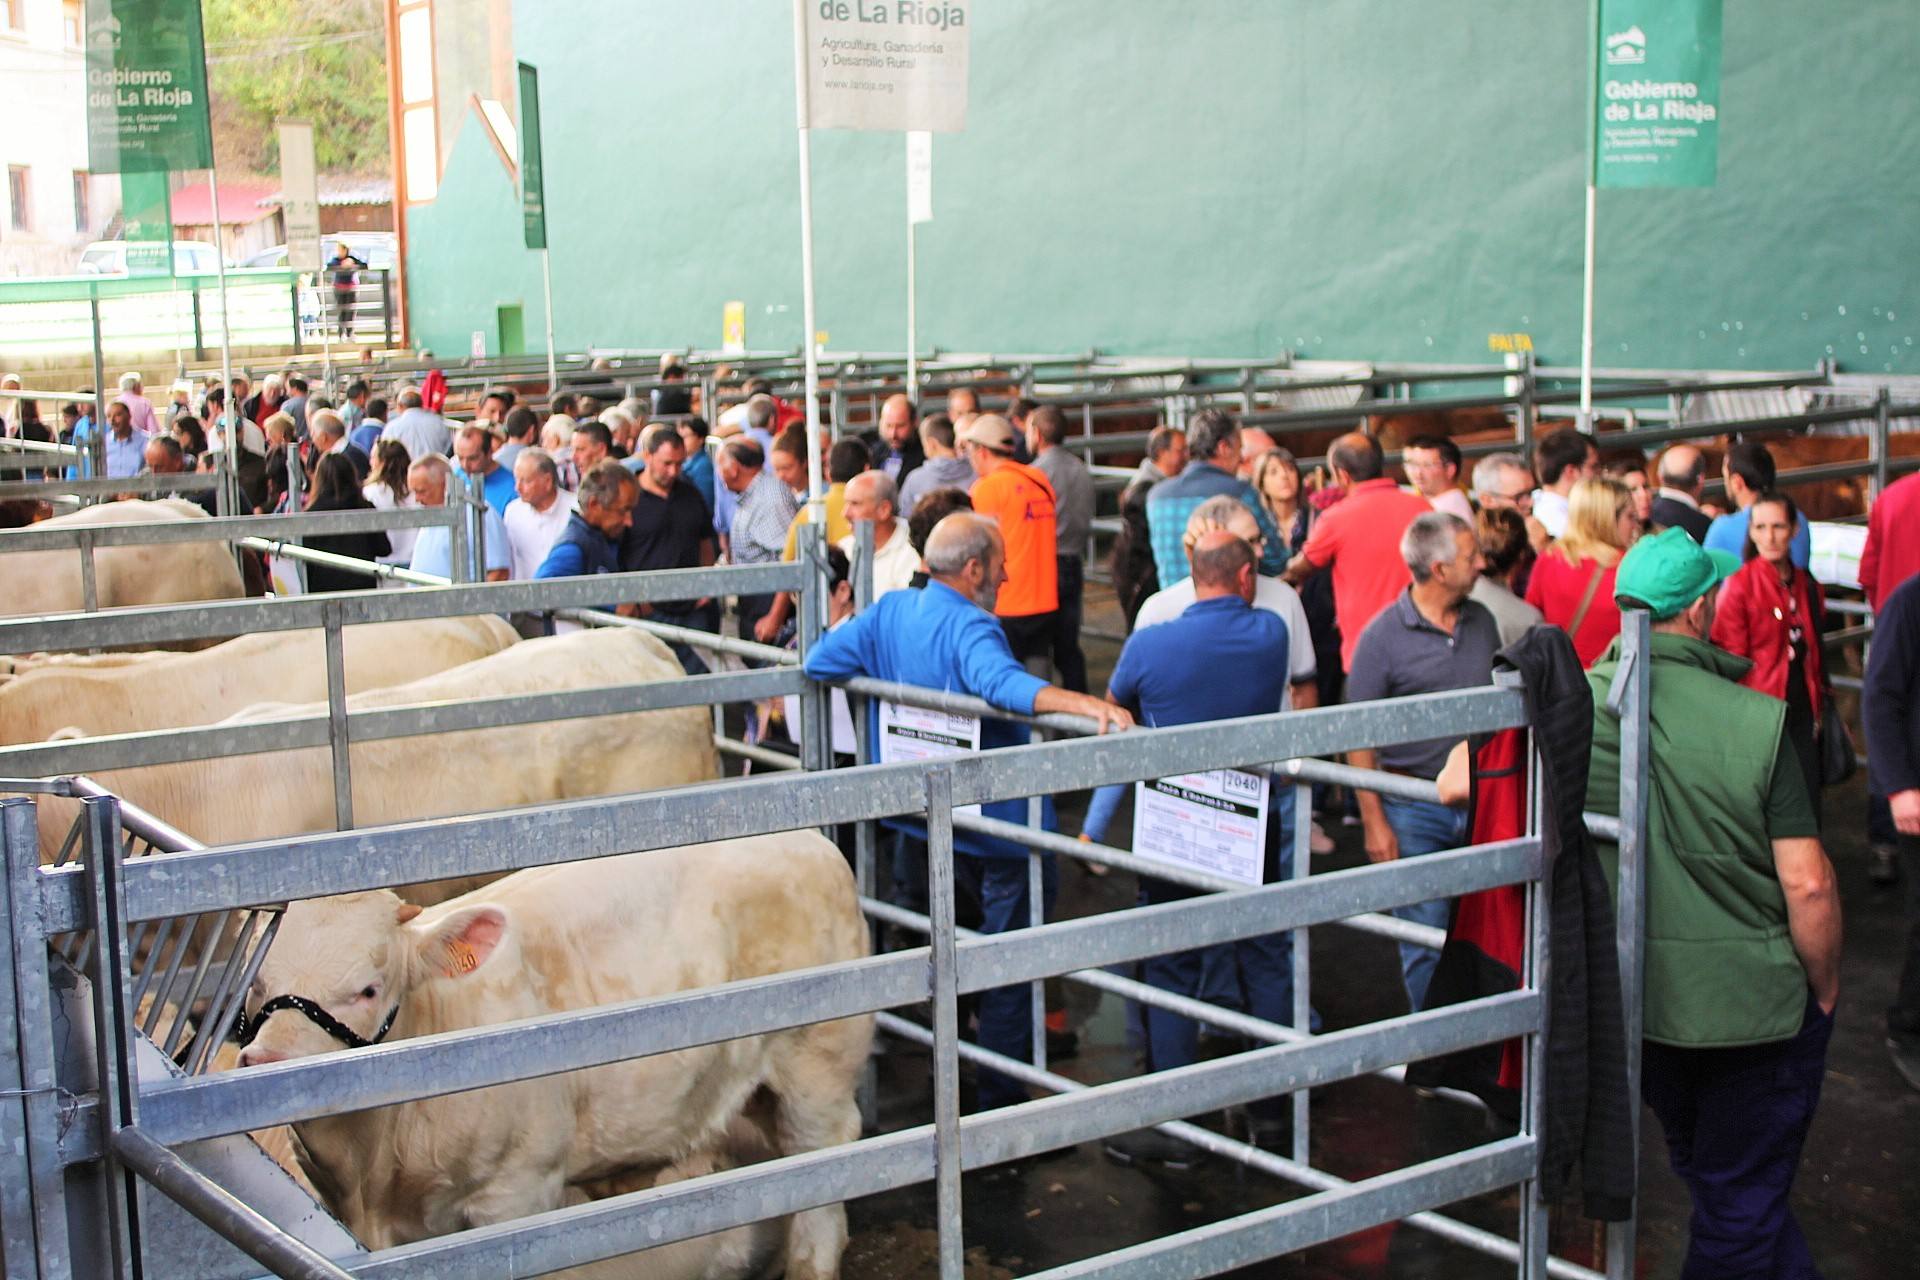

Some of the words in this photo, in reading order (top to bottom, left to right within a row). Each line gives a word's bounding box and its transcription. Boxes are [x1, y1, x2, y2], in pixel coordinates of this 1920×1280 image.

[820, 0, 849, 21] de
[858, 0, 887, 24] La
[897, 0, 964, 31] Rioja
[89, 67, 172, 85] Gobierno
[89, 90, 112, 107] de
[117, 88, 140, 107] La
[143, 87, 193, 109] Rioja
[1604, 79, 1698, 100] Gobierno
[1604, 102, 1630, 121] de
[1633, 100, 1659, 120] La
[1662, 99, 1716, 124] Rioja
